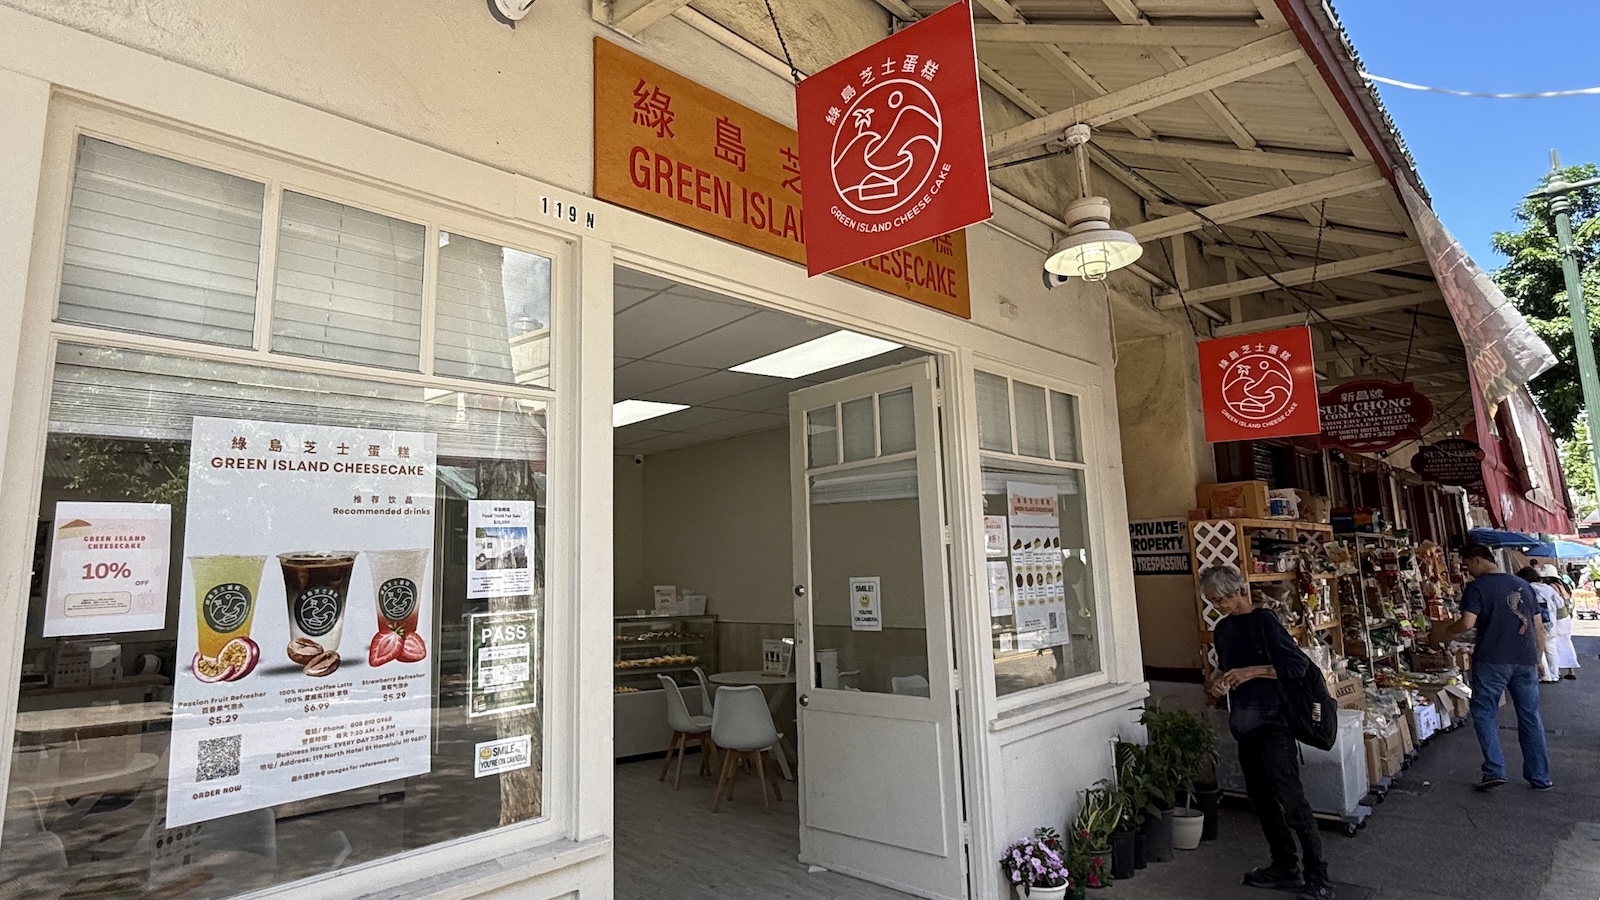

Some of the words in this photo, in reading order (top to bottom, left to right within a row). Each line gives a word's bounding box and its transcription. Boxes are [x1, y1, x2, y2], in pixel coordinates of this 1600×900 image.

[825, 54, 940, 126] 綠島芝士蛋糕
[830, 205, 856, 229] GREEN
[856, 221, 893, 233] ISLAND
[893, 194, 932, 228] CHEESE
[930, 162, 952, 195] CAKE
[541, 197, 577, 222] 119
[586, 212, 595, 230] N
[629, 145, 732, 219] GREEN
[742, 187, 805, 245] ISLA
[862, 249, 957, 298] ESECAKE
[1319, 403, 1349, 416] SUN
[1352, 397, 1412, 412] CHONG
[1221, 409, 1239, 424] GREEN
[1238, 420, 1261, 429] ISLAND
[1262, 414, 1286, 428] CHEESE
[1284, 401, 1298, 417] CAKE
[1320, 418, 1360, 427] GROCERY
[1363, 413, 1411, 423] IMPORTER
[1338, 428, 1359, 436] NORTH
[1359, 426, 1382, 434] HOTEL
[1383, 424, 1409, 432] STREET
[231, 435, 411, 460] 綠島芝士蛋糕
[210, 456, 268, 470] GREEN
[272, 459, 330, 472] ISLAND
[333, 462, 424, 476] CHEESECAKE
[353, 494, 414, 505] 推荐饮品
[332, 507, 402, 516] Recommended
[403, 507, 431, 516] drinks
[1129, 521, 1179, 536] PRIVATE
[87, 542, 141, 550] CHEESECAKE
[1131, 535, 1184, 552] ROPERTY
[81, 561, 132, 580] 10%
[1136, 555, 1189, 571] TRESPASSING
[481, 625, 527, 644] PASS
[361, 676, 397, 687] Strawberry
[398, 672, 426, 682] Refresher
[279, 688, 297, 696] 100%
[298, 685, 314, 694] Kona
[314, 683, 337, 693] Coffee
[337, 680, 353, 689] Latte
[177, 697, 209, 709] Passion
[210, 695, 230, 705] Fruit
[230, 690, 267, 703] Refresher
[284, 695, 303, 704] 100%
[383, 691, 407, 702] $5.29
[304, 702, 330, 713] $6.99
[208, 713, 239, 726] $5.29
[349, 728, 364, 737] 7:30
[363, 727, 375, 736] AM
[385, 724, 396, 732] PM
[276, 747, 308, 759] Business
[309, 743, 333, 753] Hours:
[333, 738, 355, 749] EVERY
[356, 735, 371, 745] DAY
[370, 734, 384, 742] 7:30
[384, 732, 395, 740] AM
[405, 728, 415, 736] PM
[279, 756, 312, 767] Address:
[312, 753, 323, 762] 119
[324, 749, 345, 760] North
[346, 746, 365, 756] Hotel
[365, 744, 373, 752] St
[372, 739, 402, 750] Honolulu
[350, 763, 359, 771] for
[359, 758, 386, 769] reference
[386, 755, 400, 765] only
[192, 787, 221, 800] ORDER
[221, 784, 242, 796] NOW
